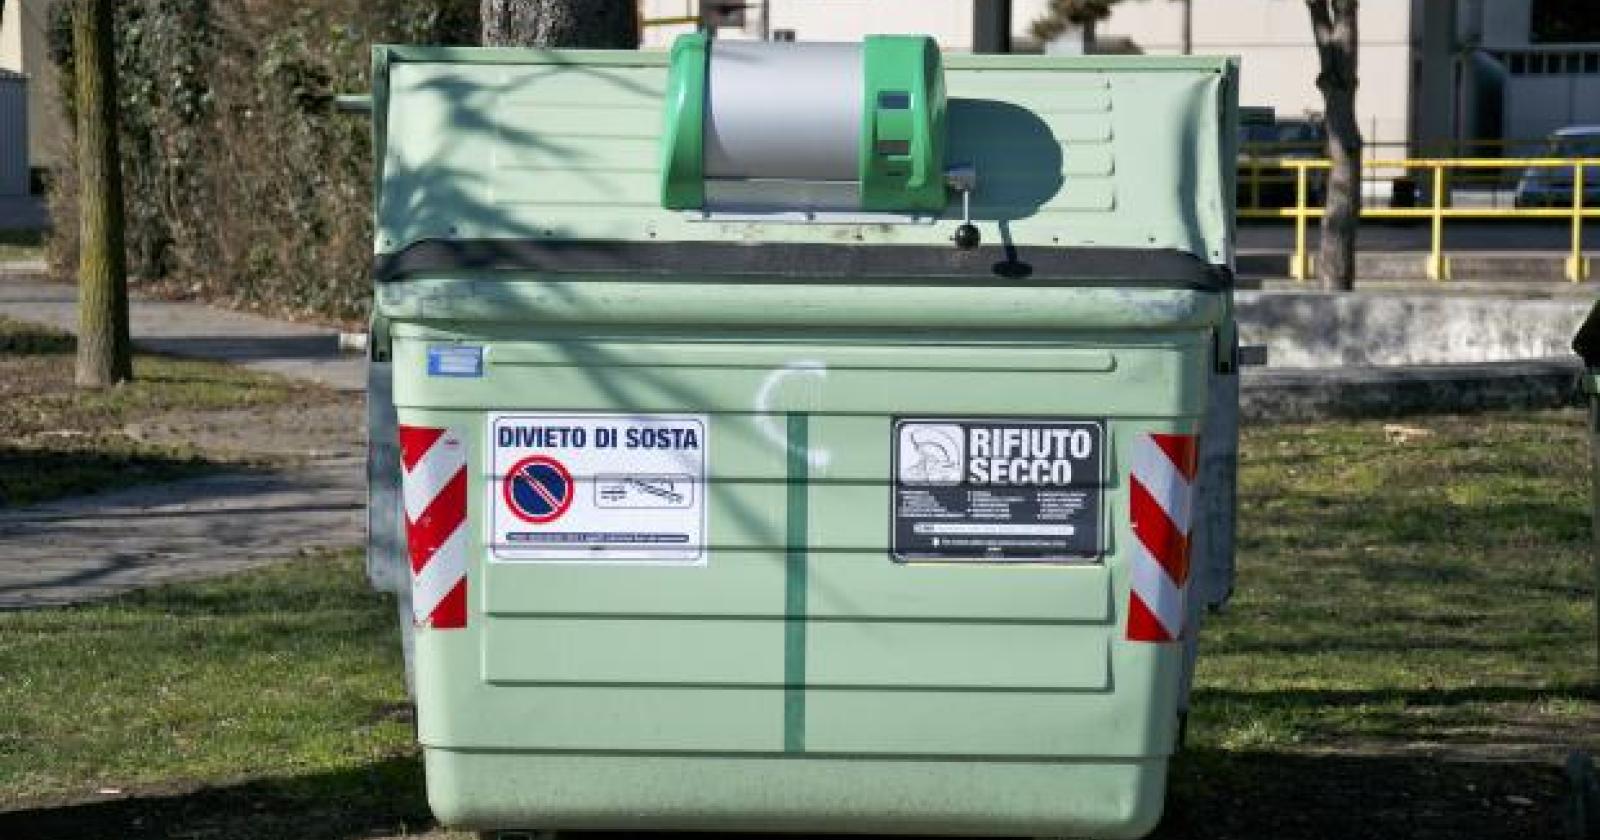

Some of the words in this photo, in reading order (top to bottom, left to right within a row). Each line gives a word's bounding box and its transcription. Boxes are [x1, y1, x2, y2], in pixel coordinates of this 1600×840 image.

[497, 426, 587, 448] DIVIETO
[595, 428, 618, 448] DI
[626, 428, 699, 450] SOSTA
[969, 428, 1092, 459] RIFIUTO
[969, 459, 1072, 484] SECCO
